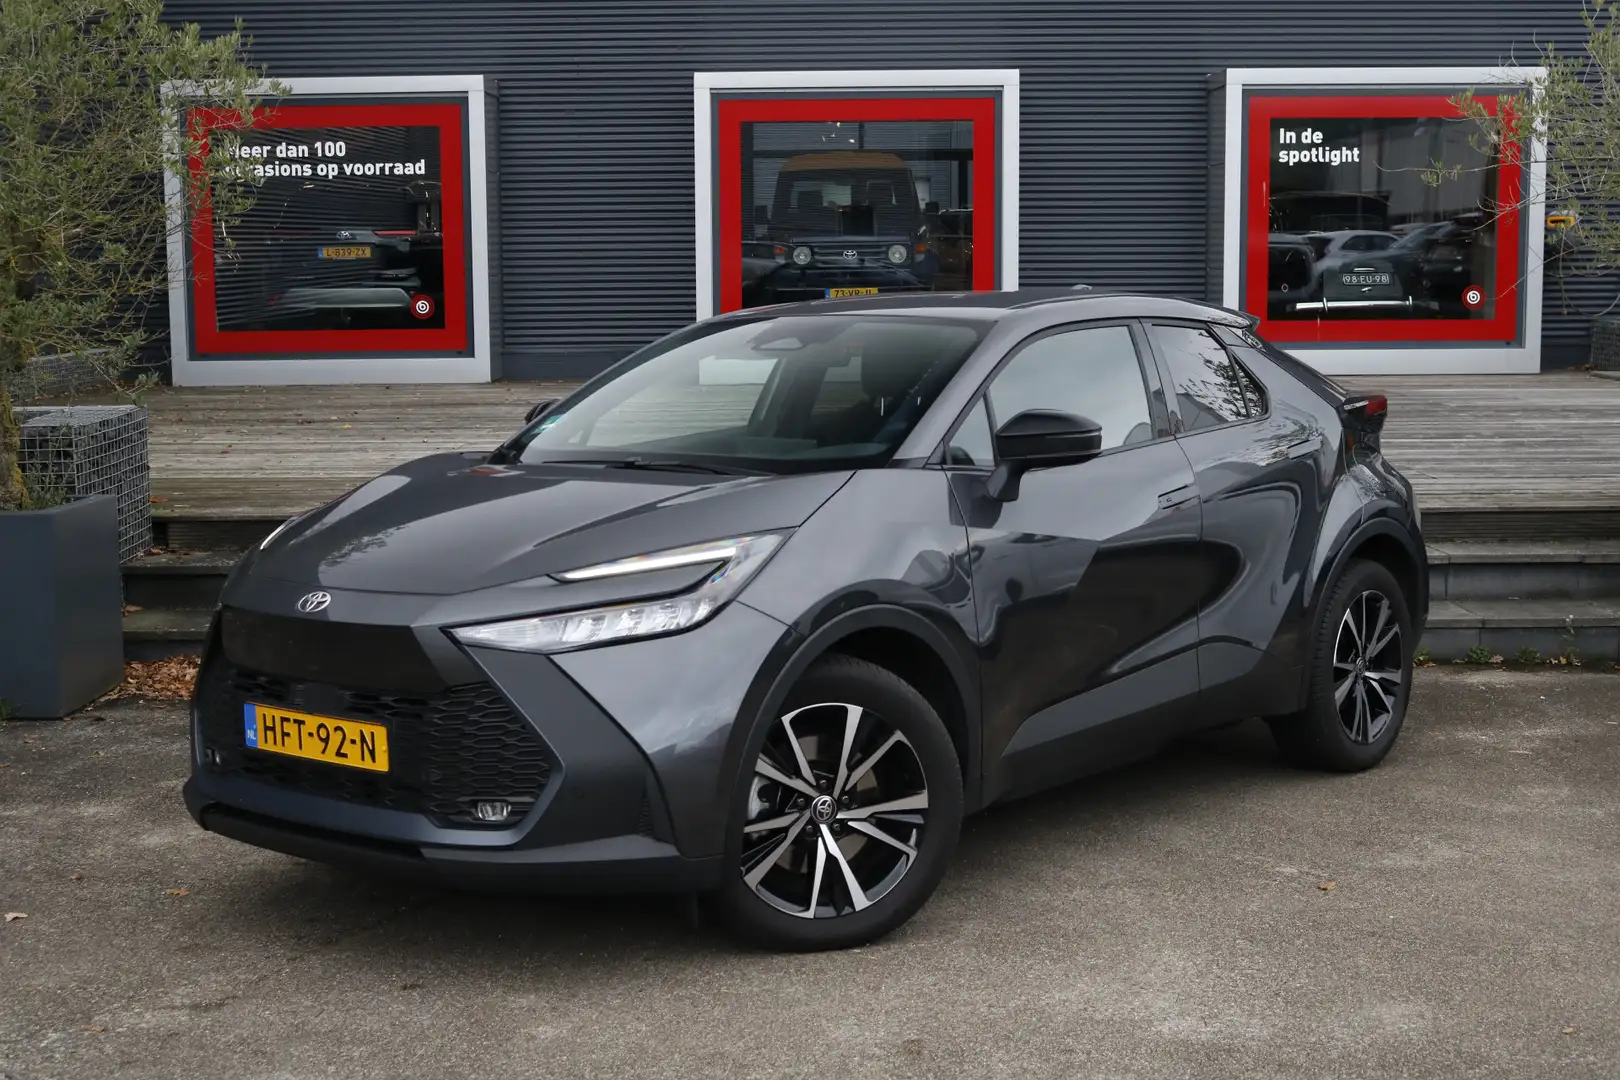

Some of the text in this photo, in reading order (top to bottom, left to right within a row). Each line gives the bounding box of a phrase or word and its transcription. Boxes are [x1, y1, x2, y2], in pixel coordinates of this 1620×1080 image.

[1279, 128, 1323, 144] In de
[276, 142, 308, 158] dan
[314, 141, 346, 157] 100
[1278, 147, 1360, 166] spotlight
[225, 159, 426, 179] asions op voorraad
[326, 248, 367, 257] L-839-ZX
[262, 712, 377, 764] HFT-92-N
